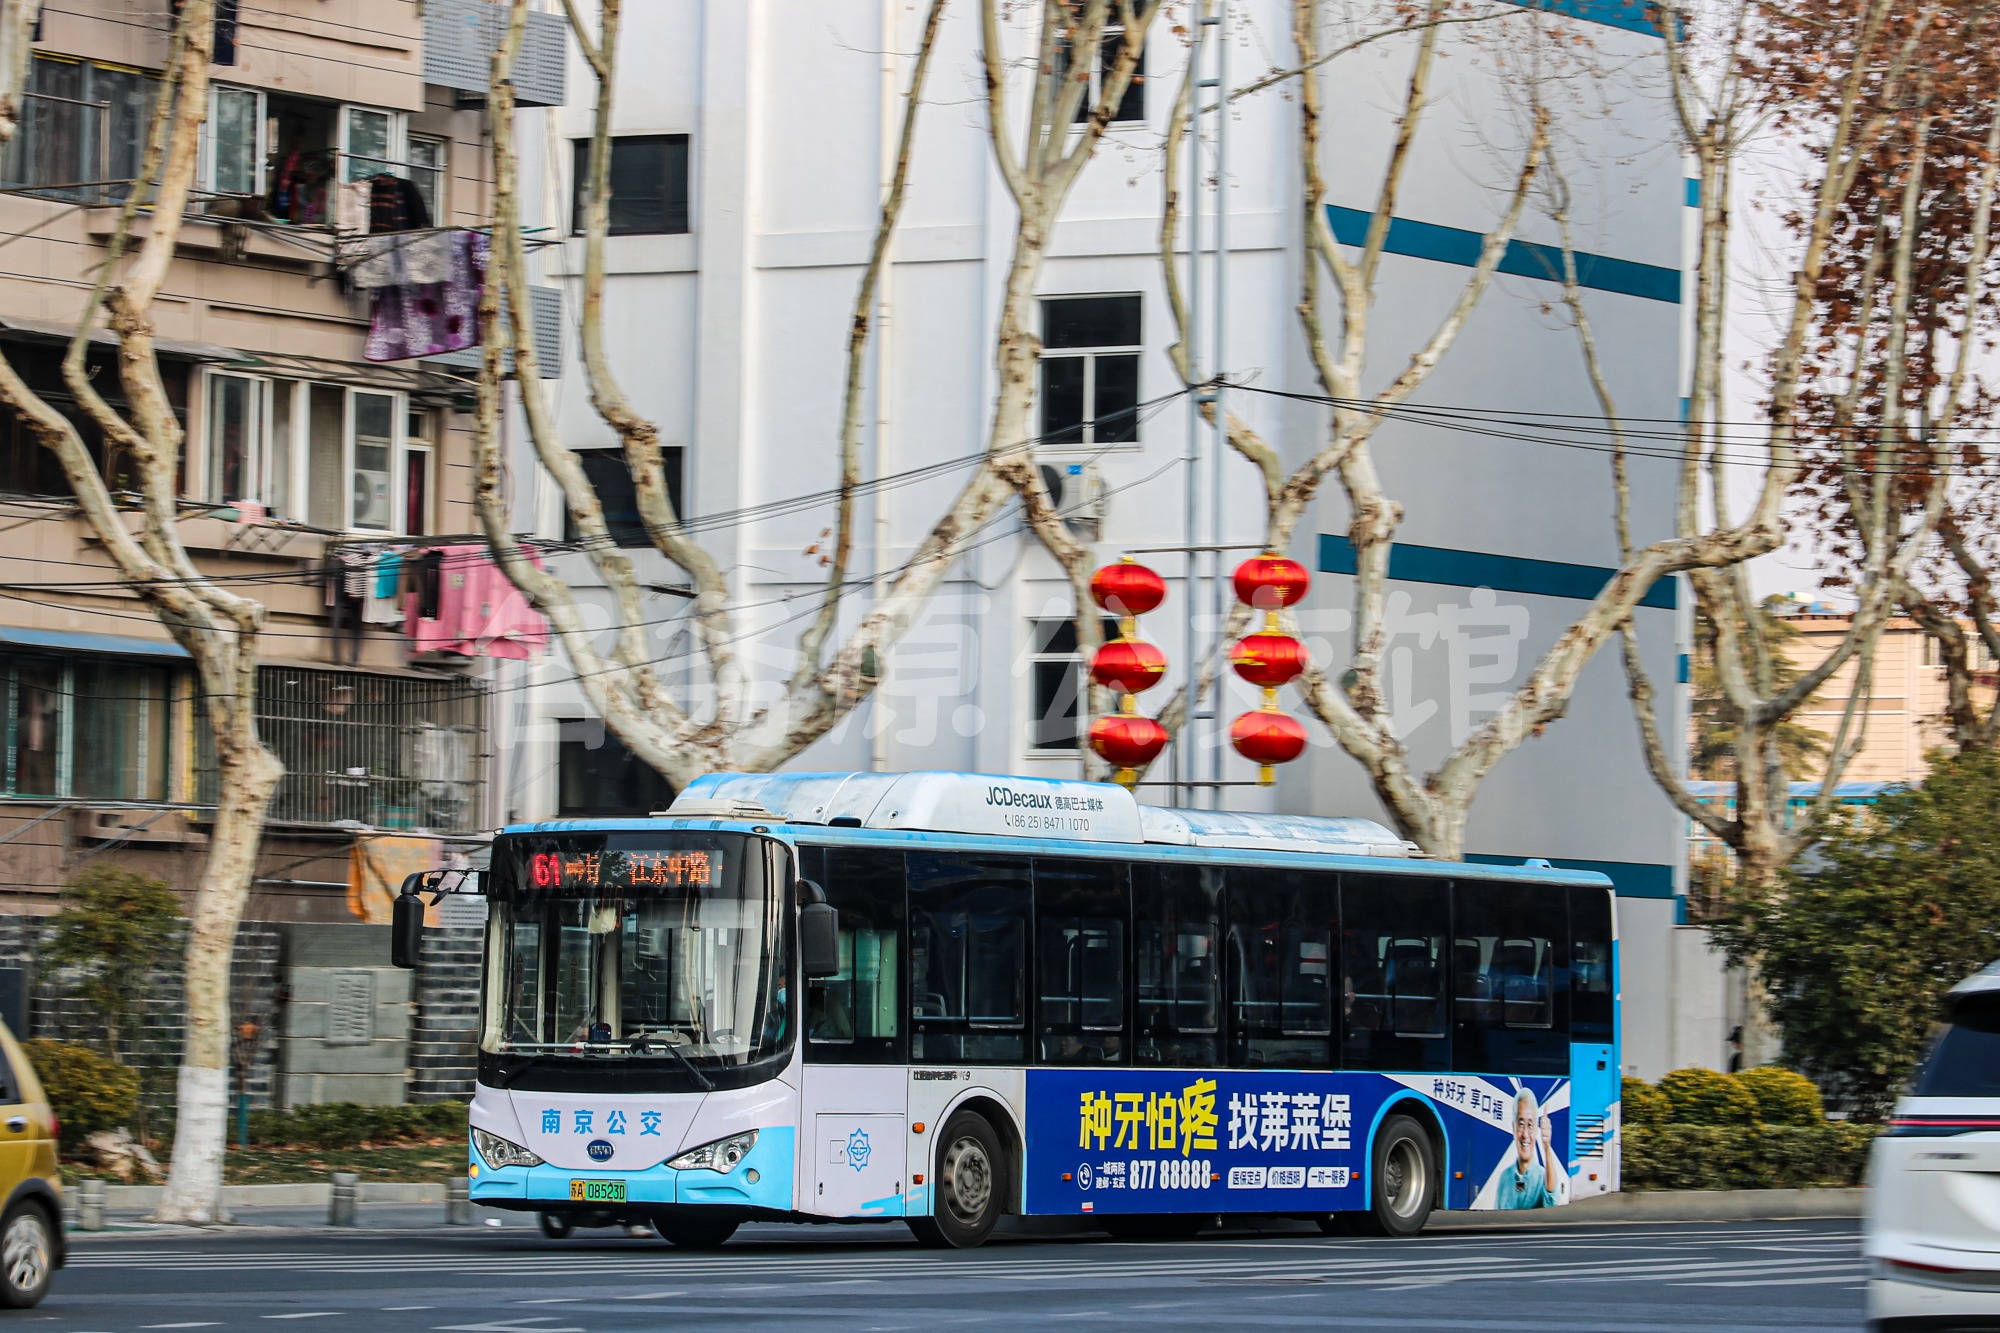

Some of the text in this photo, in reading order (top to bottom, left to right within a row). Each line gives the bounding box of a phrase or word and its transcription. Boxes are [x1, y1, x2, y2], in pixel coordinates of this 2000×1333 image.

[986, 786, 1104, 812] JCDecaux 德高巴士媒体
[1011, 814, 1090, 831] (86 25) 8471 1070
[533, 852, 561, 887] 61
[1433, 1078, 1504, 1121] 种好牙 享口福
[541, 1108, 662, 1136] 南京公交
[1079, 1077, 1352, 1158] 种牙怕疼 找茀莱堡
[1095, 1161, 1126, 1175] 一城两院
[1129, 1159, 1211, 1190] 877 88888
[1232, 1169, 1346, 1186] 医保定点 价格透明 一对一服务
[588, 1183, 625, 1200] 08523D
